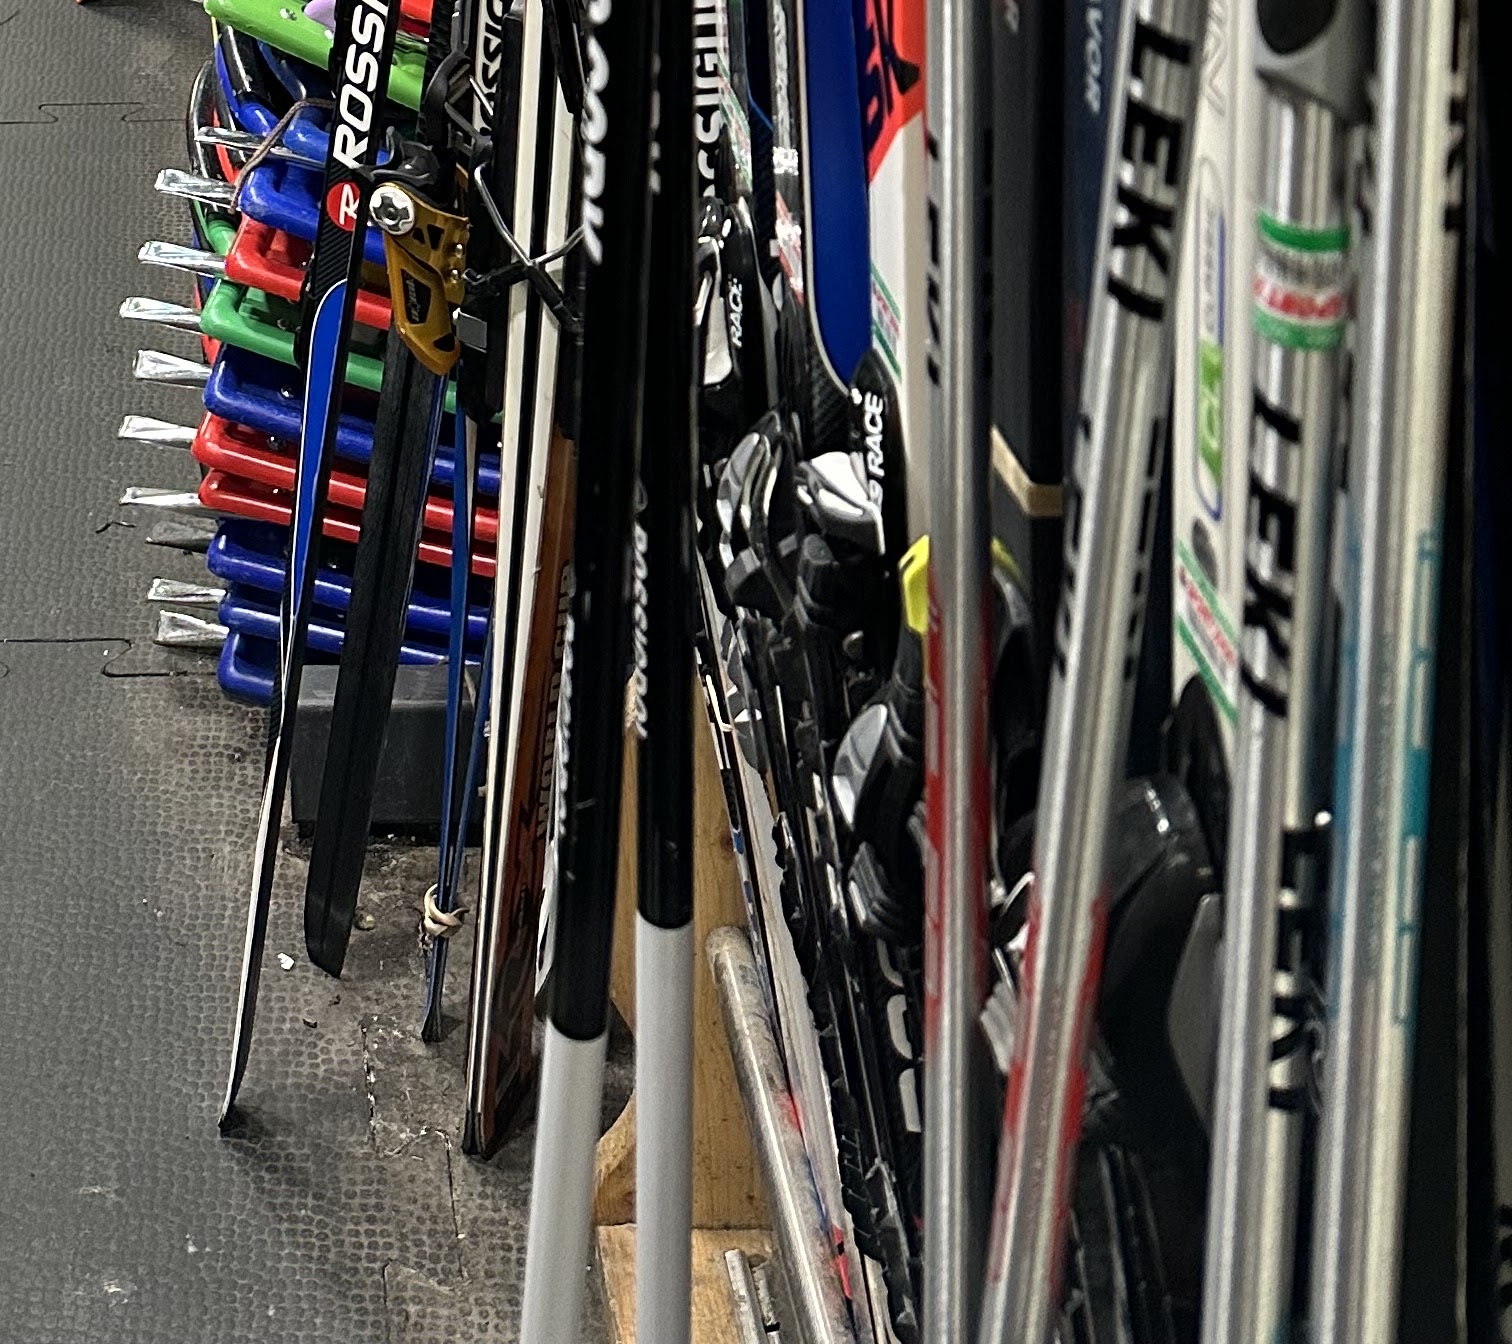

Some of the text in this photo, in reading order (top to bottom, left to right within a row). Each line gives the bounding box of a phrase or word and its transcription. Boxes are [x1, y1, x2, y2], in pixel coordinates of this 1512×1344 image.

[1106, 7, 1193, 324] LEKI
[865, 391, 886, 480] RACE
[1240, 388, 1304, 719] LEKI
